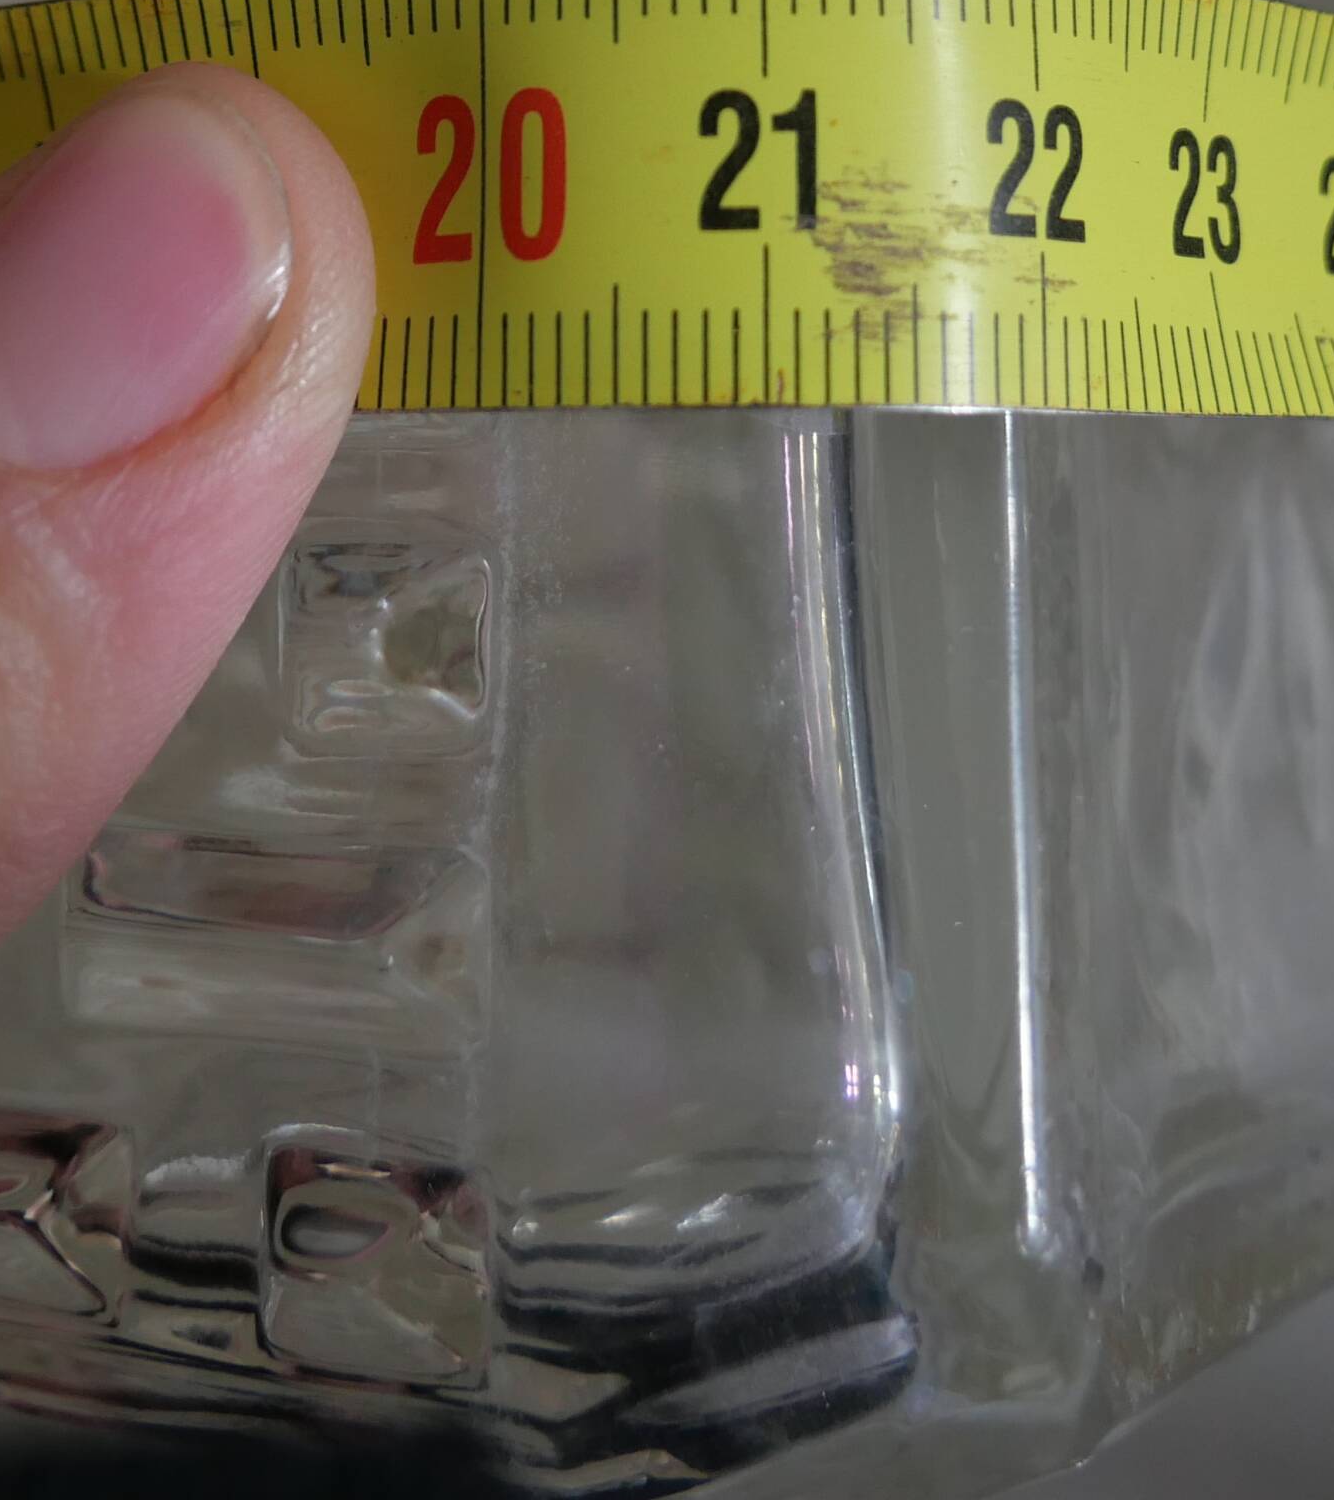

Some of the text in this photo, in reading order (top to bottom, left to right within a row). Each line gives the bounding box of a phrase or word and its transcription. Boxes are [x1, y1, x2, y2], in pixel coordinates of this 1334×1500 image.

[412, 87, 568, 265] 20
[698, 88, 818, 231] 21
[987, 99, 1086, 244] 22
[1168, 128, 1242, 265] 23
